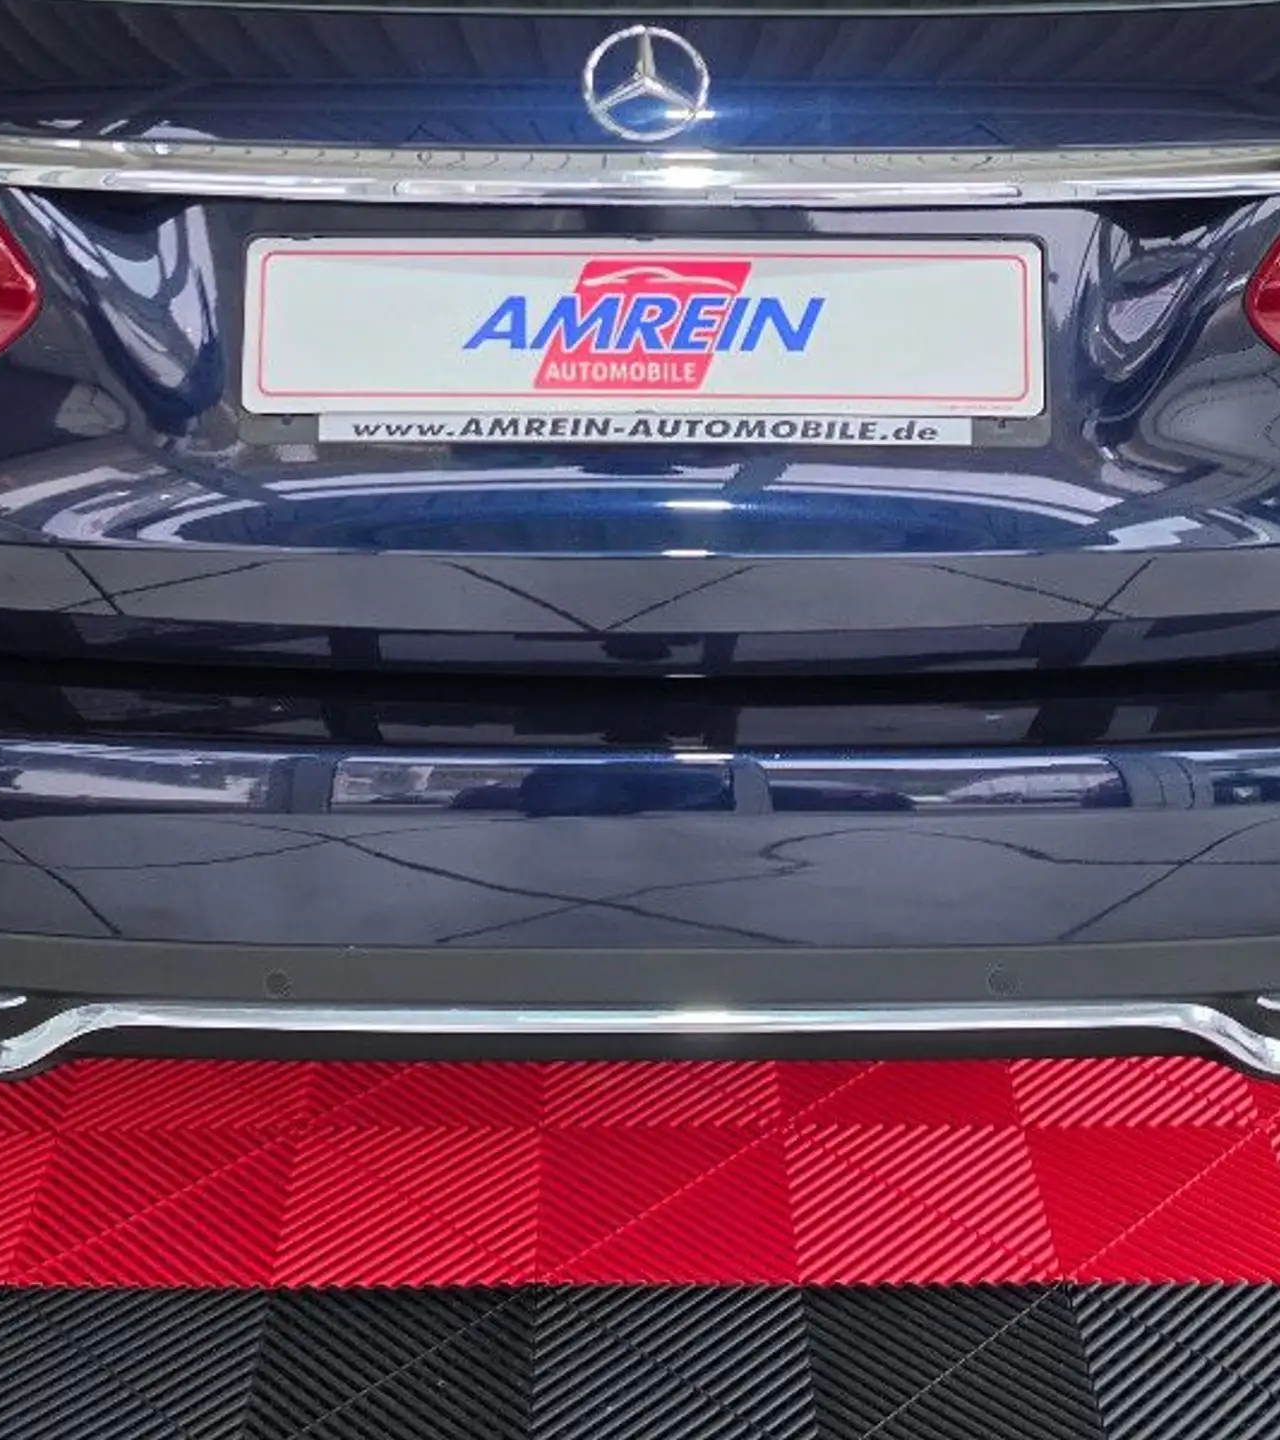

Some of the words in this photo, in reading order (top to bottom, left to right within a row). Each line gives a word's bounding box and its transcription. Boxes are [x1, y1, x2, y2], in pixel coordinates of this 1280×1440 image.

[463, 295, 826, 352] AMREIN
[546, 361, 697, 383] AUTOMOBILE
[351, 417, 939, 442] www.AMREIN-AUTOMOBILE.de
